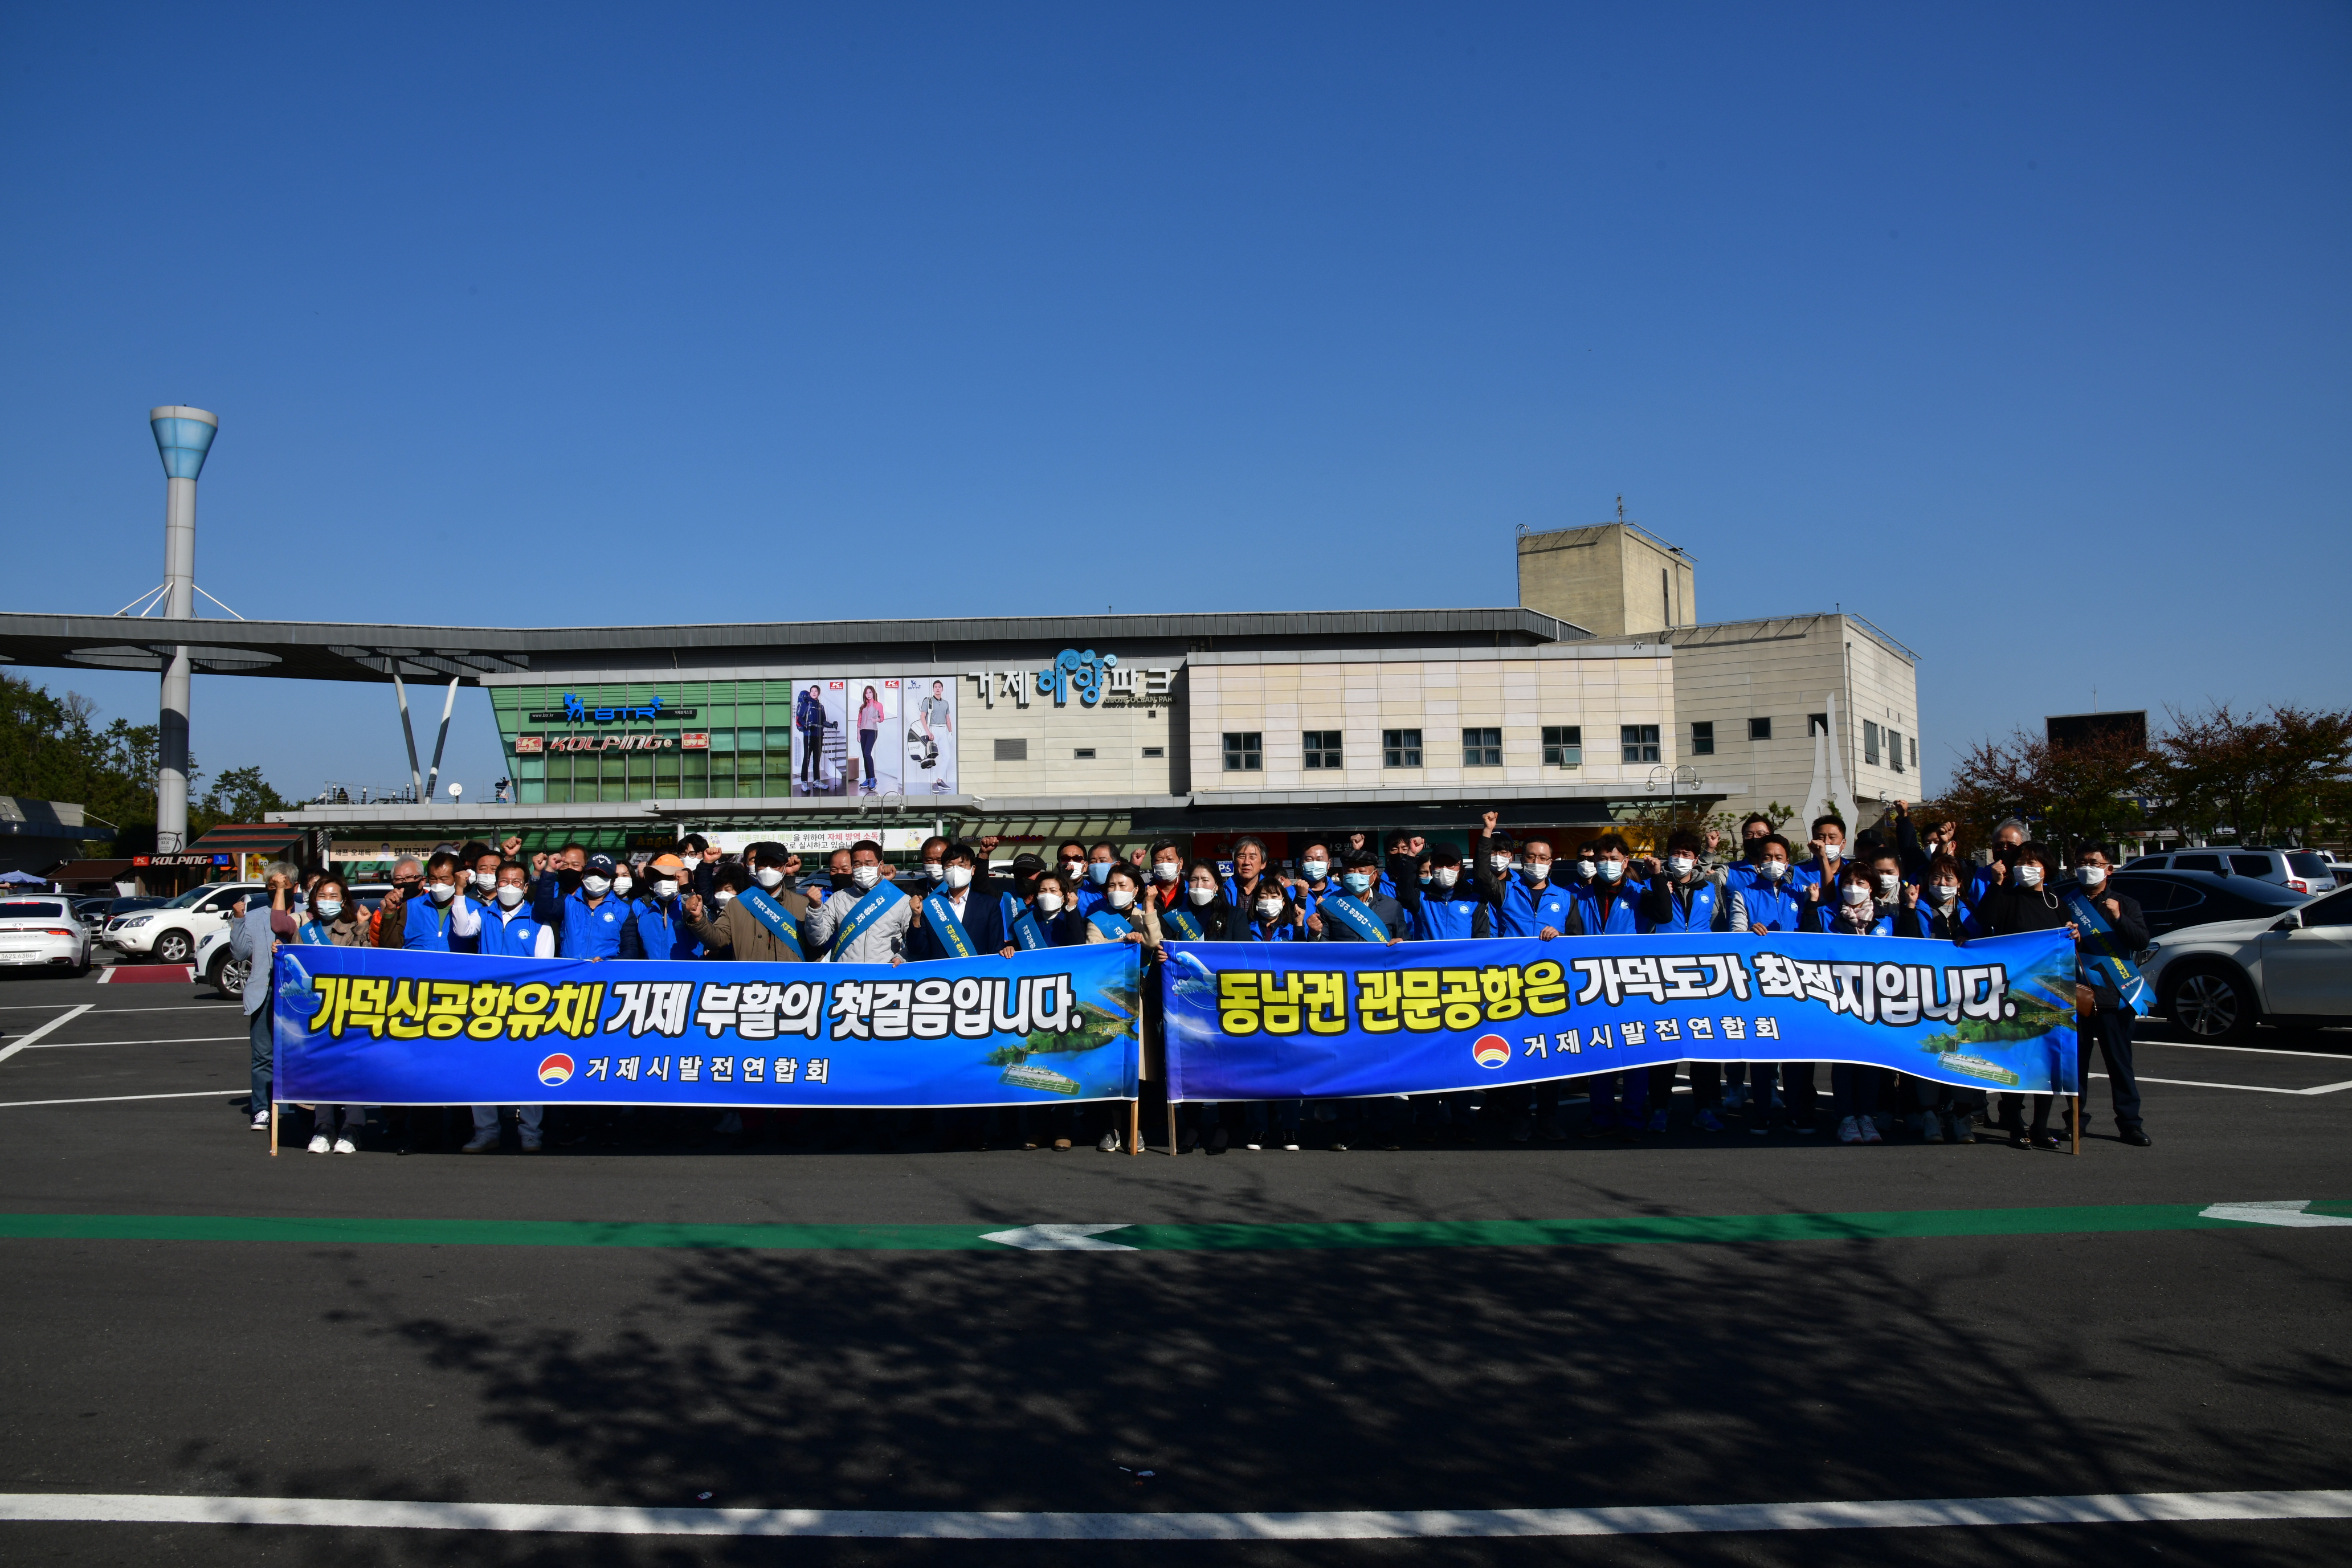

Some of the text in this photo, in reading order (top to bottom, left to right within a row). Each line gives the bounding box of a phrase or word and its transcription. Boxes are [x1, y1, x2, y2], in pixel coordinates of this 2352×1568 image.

[969, 665, 1172, 704] 거제해양파크
[595, 708, 655, 720] BTR
[549, 735, 664, 752] KOLPING
[151, 856, 207, 865] KOLPING
[592, 854, 612, 864] Callaway
[1336, 897, 1350, 911] 가덕이
[1220, 954, 2015, 1033] 동남권 관문공항은 가덕도가 최적지입니다.
[311, 975, 1081, 1038] 가덕신공항유치! 거제 부활의 첫걸음입니다.
